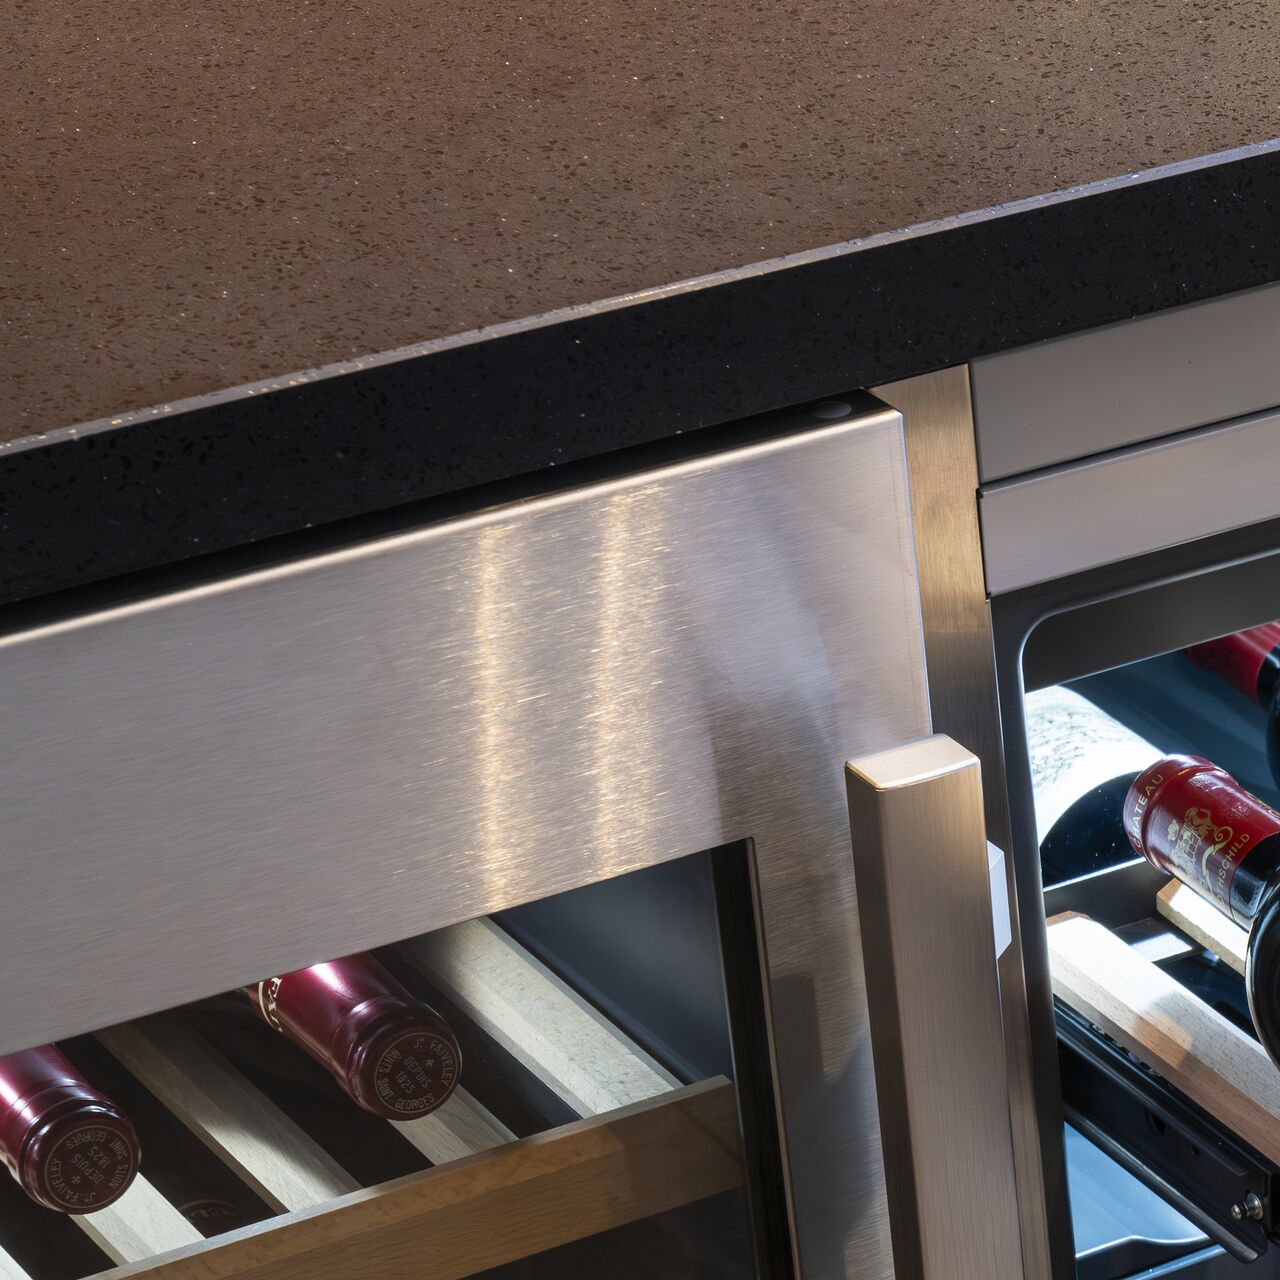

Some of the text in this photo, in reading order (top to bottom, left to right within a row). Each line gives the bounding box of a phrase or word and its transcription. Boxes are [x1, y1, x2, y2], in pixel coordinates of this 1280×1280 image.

[1131, 774, 1164, 848] CHATEAU
[1215, 832, 1250, 904] OTHSCHILD
[394, 1071, 416, 1094] 1825
[403, 1055, 432, 1089] DEPUIS
[429, 1039, 454, 1086] FAIVELEY
[377, 1079, 395, 1100] SAINT
[394, 1092, 436, 1111] GEORGES
[51, 1158, 80, 1203] FAIVELEY
